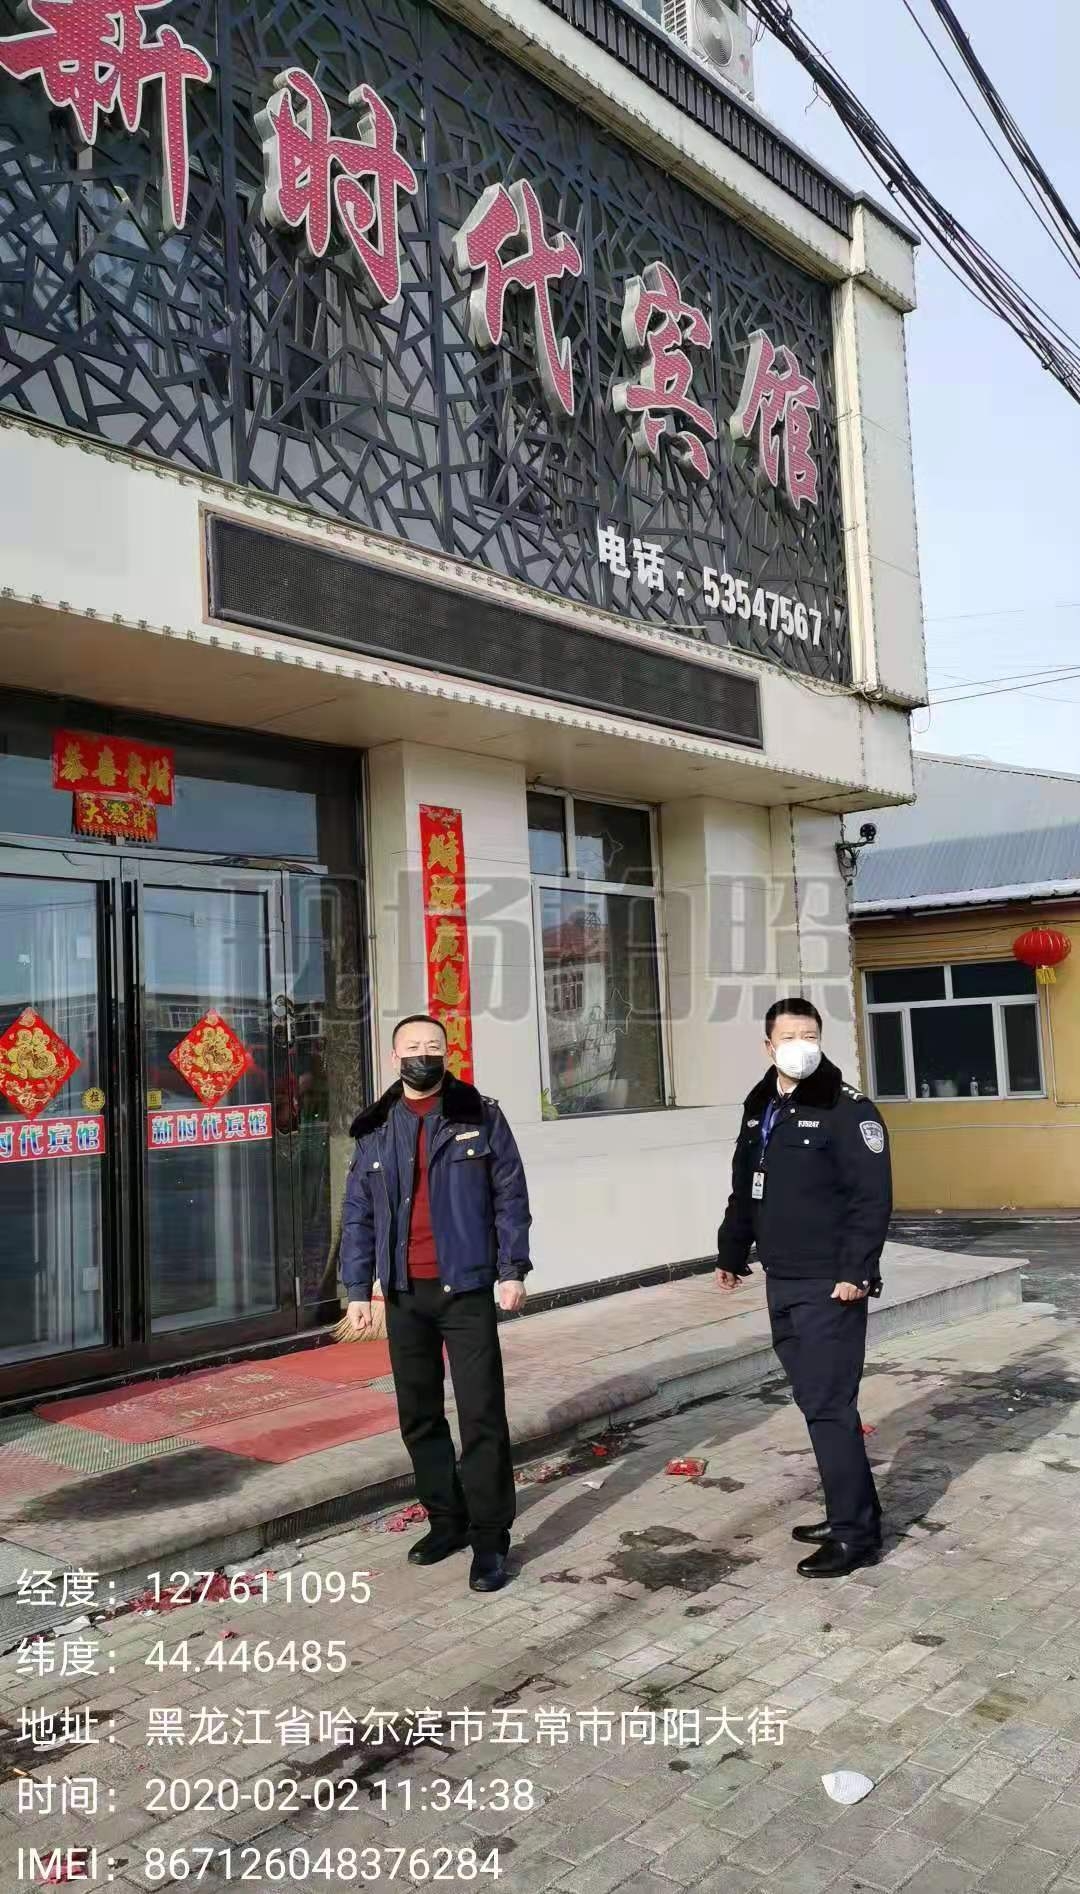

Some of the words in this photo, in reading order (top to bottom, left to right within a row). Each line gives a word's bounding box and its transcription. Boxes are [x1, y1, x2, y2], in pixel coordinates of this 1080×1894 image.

[0, 0, 820, 510] 新时代宾馆
[152, 1108, 268, 1145] 新时代宾馆
